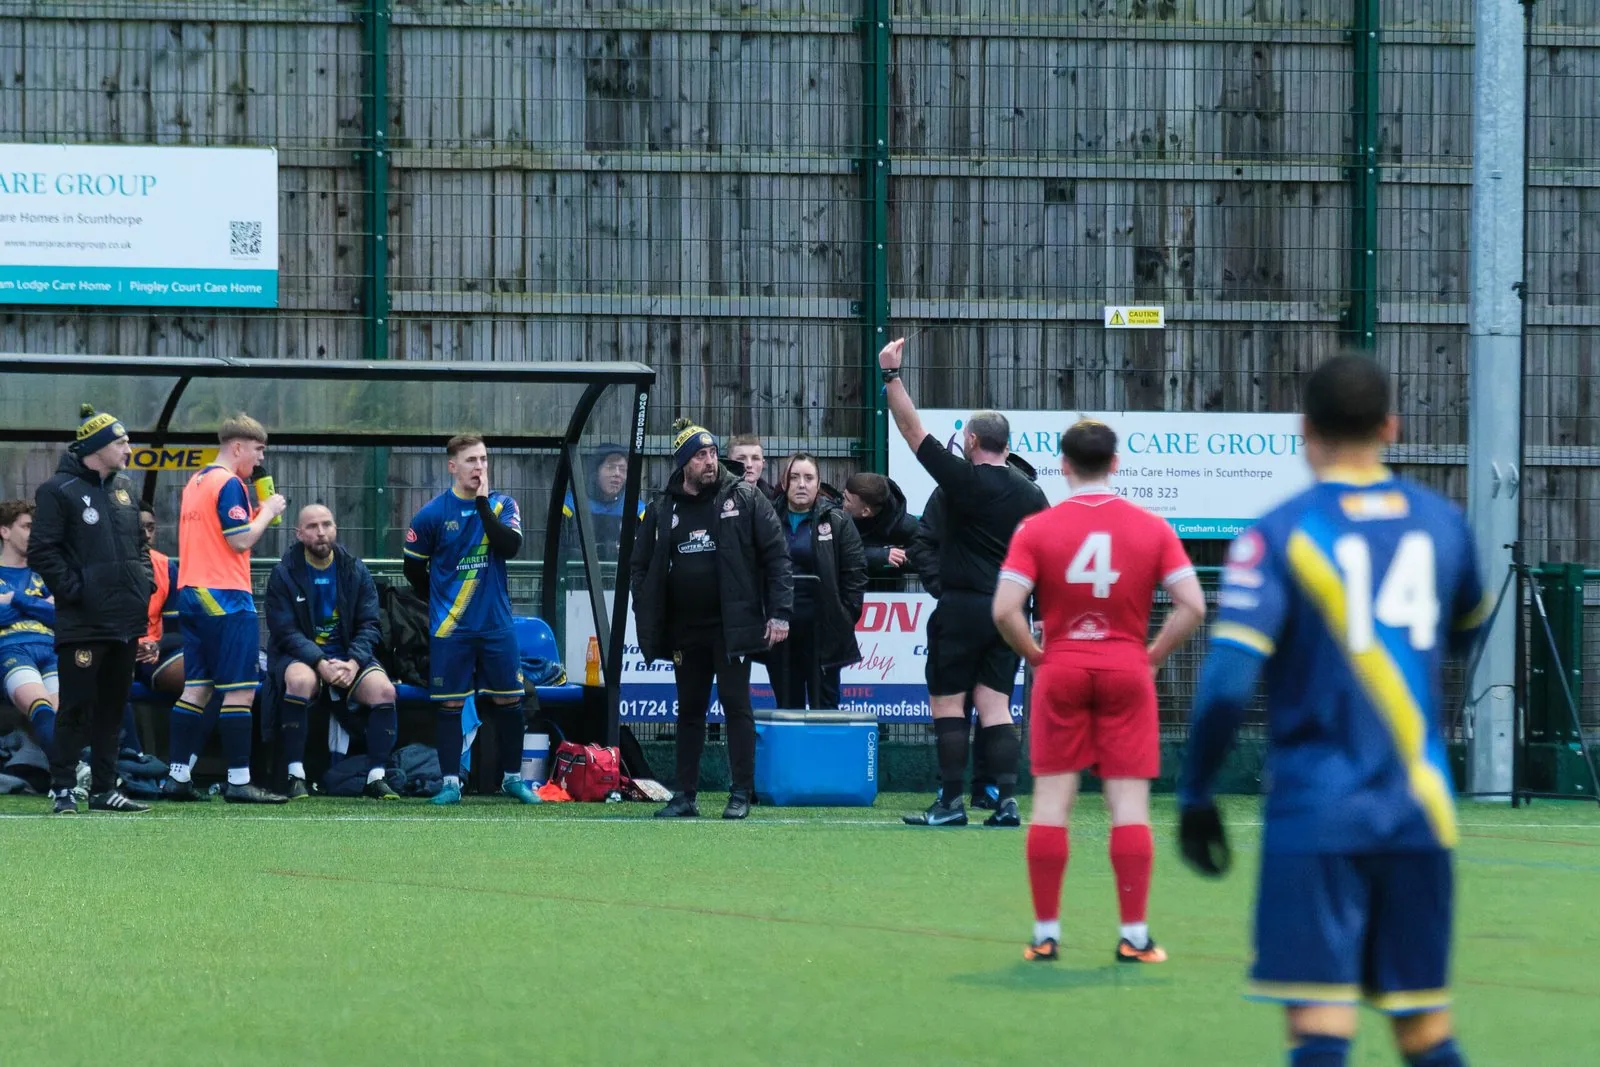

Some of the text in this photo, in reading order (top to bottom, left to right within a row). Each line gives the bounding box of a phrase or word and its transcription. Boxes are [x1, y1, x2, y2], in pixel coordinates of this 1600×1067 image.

[55, 172, 157, 197] GROUP
[20, 212, 60, 224] Homes
[63, 213, 75, 224] in
[77, 213, 143, 228] Scunthorpe
[16, 280, 50, 292] Lodge
[52, 280, 76, 290] Care
[79, 281, 112, 291] Home
[130, 281, 169, 294] Pingley
[171, 281, 201, 292] Court
[204, 282, 228, 293] Care
[230, 283, 263, 294] Home
[1127, 431, 1200, 455] CARE
[1207, 432, 1305, 456] GROUP
[1140, 467, 1163, 478] Care
[1166, 467, 1201, 479] Homes
[1203, 467, 1213, 478] in
[1215, 467, 1273, 480] Scunthorpe
[1131, 487, 1154, 499] 708
[1157, 487, 1179, 499] 323
[1178, 524, 1245, 536] Gresham Lodge
[1065, 530, 1121, 598] 4
[1333, 530, 1441, 653] 14
[854, 602, 922, 632] ON
[635, 660, 674, 672] Gara
[619, 700, 667, 717] 01724
[867, 731, 876, 782] Coleman
